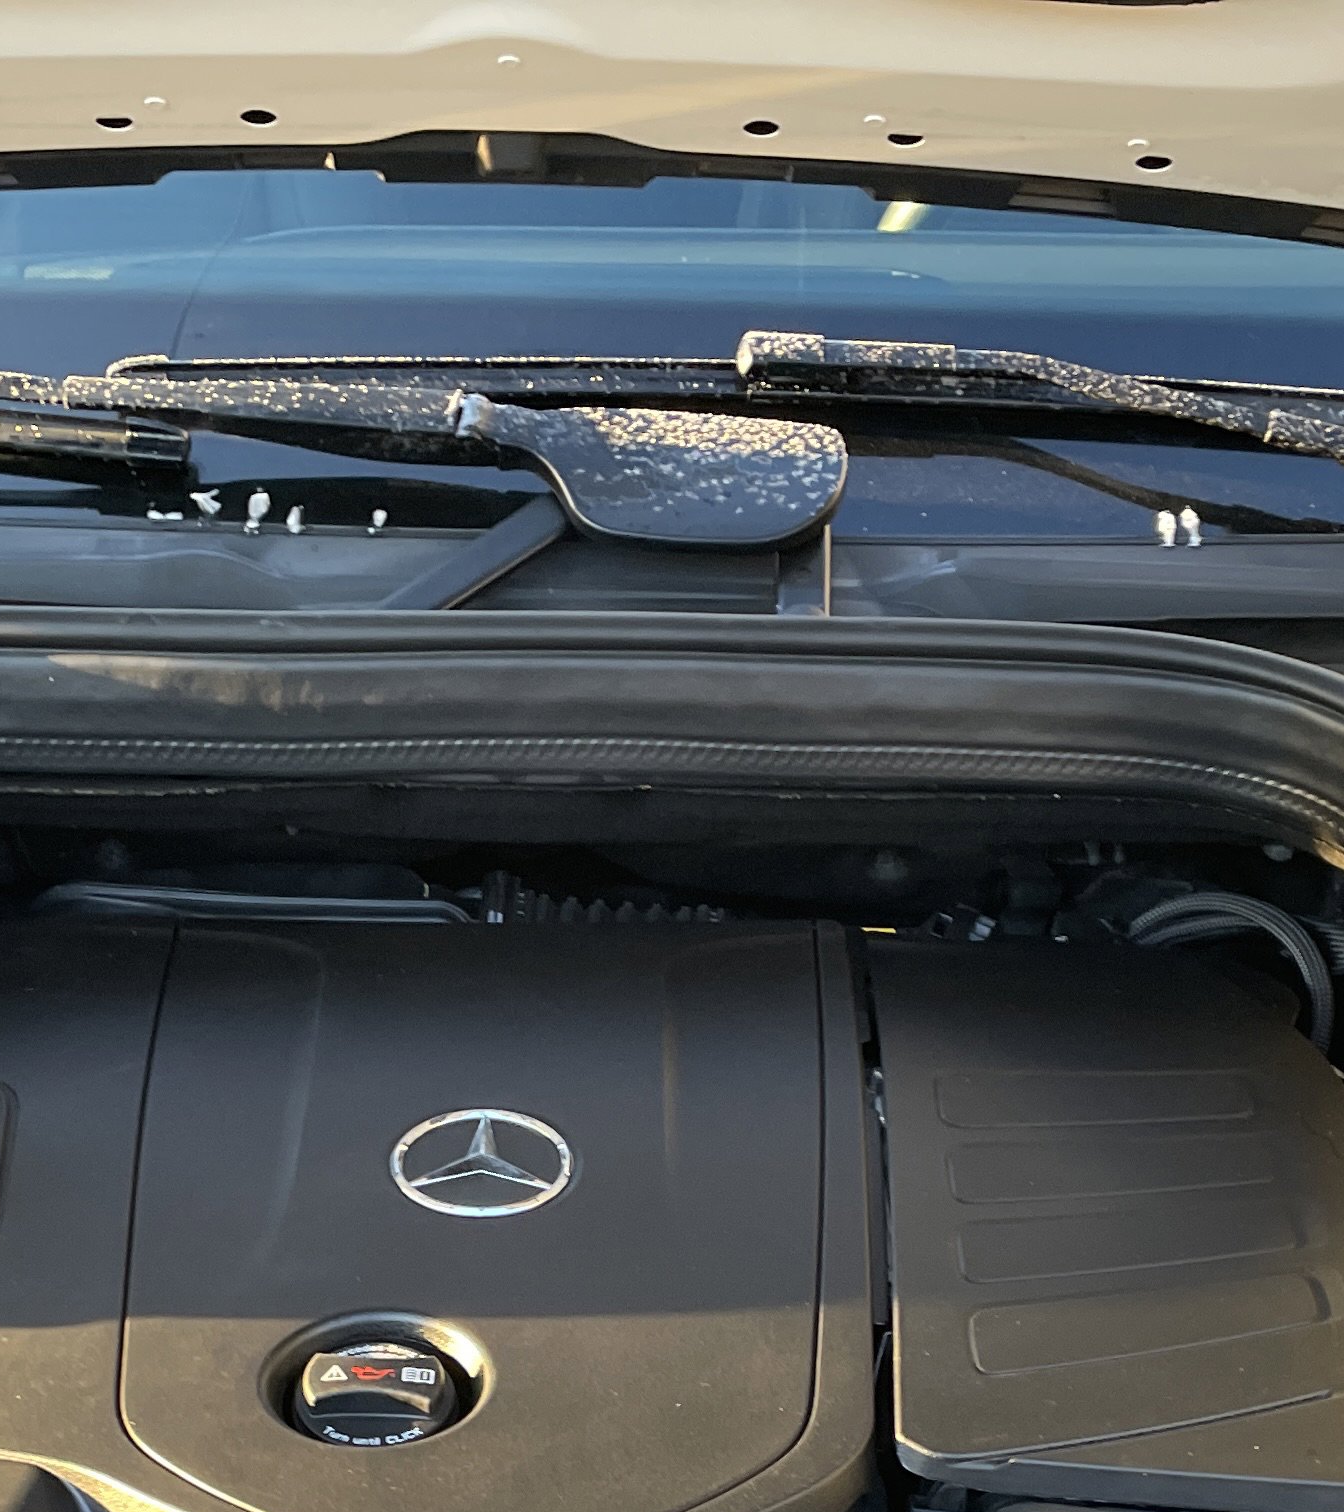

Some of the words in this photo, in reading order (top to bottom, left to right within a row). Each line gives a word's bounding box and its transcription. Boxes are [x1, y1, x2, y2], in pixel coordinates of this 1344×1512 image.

[322, 1425, 350, 1443] Turn
[352, 1437, 381, 1446] until
[384, 1426, 424, 1445] CLICK
